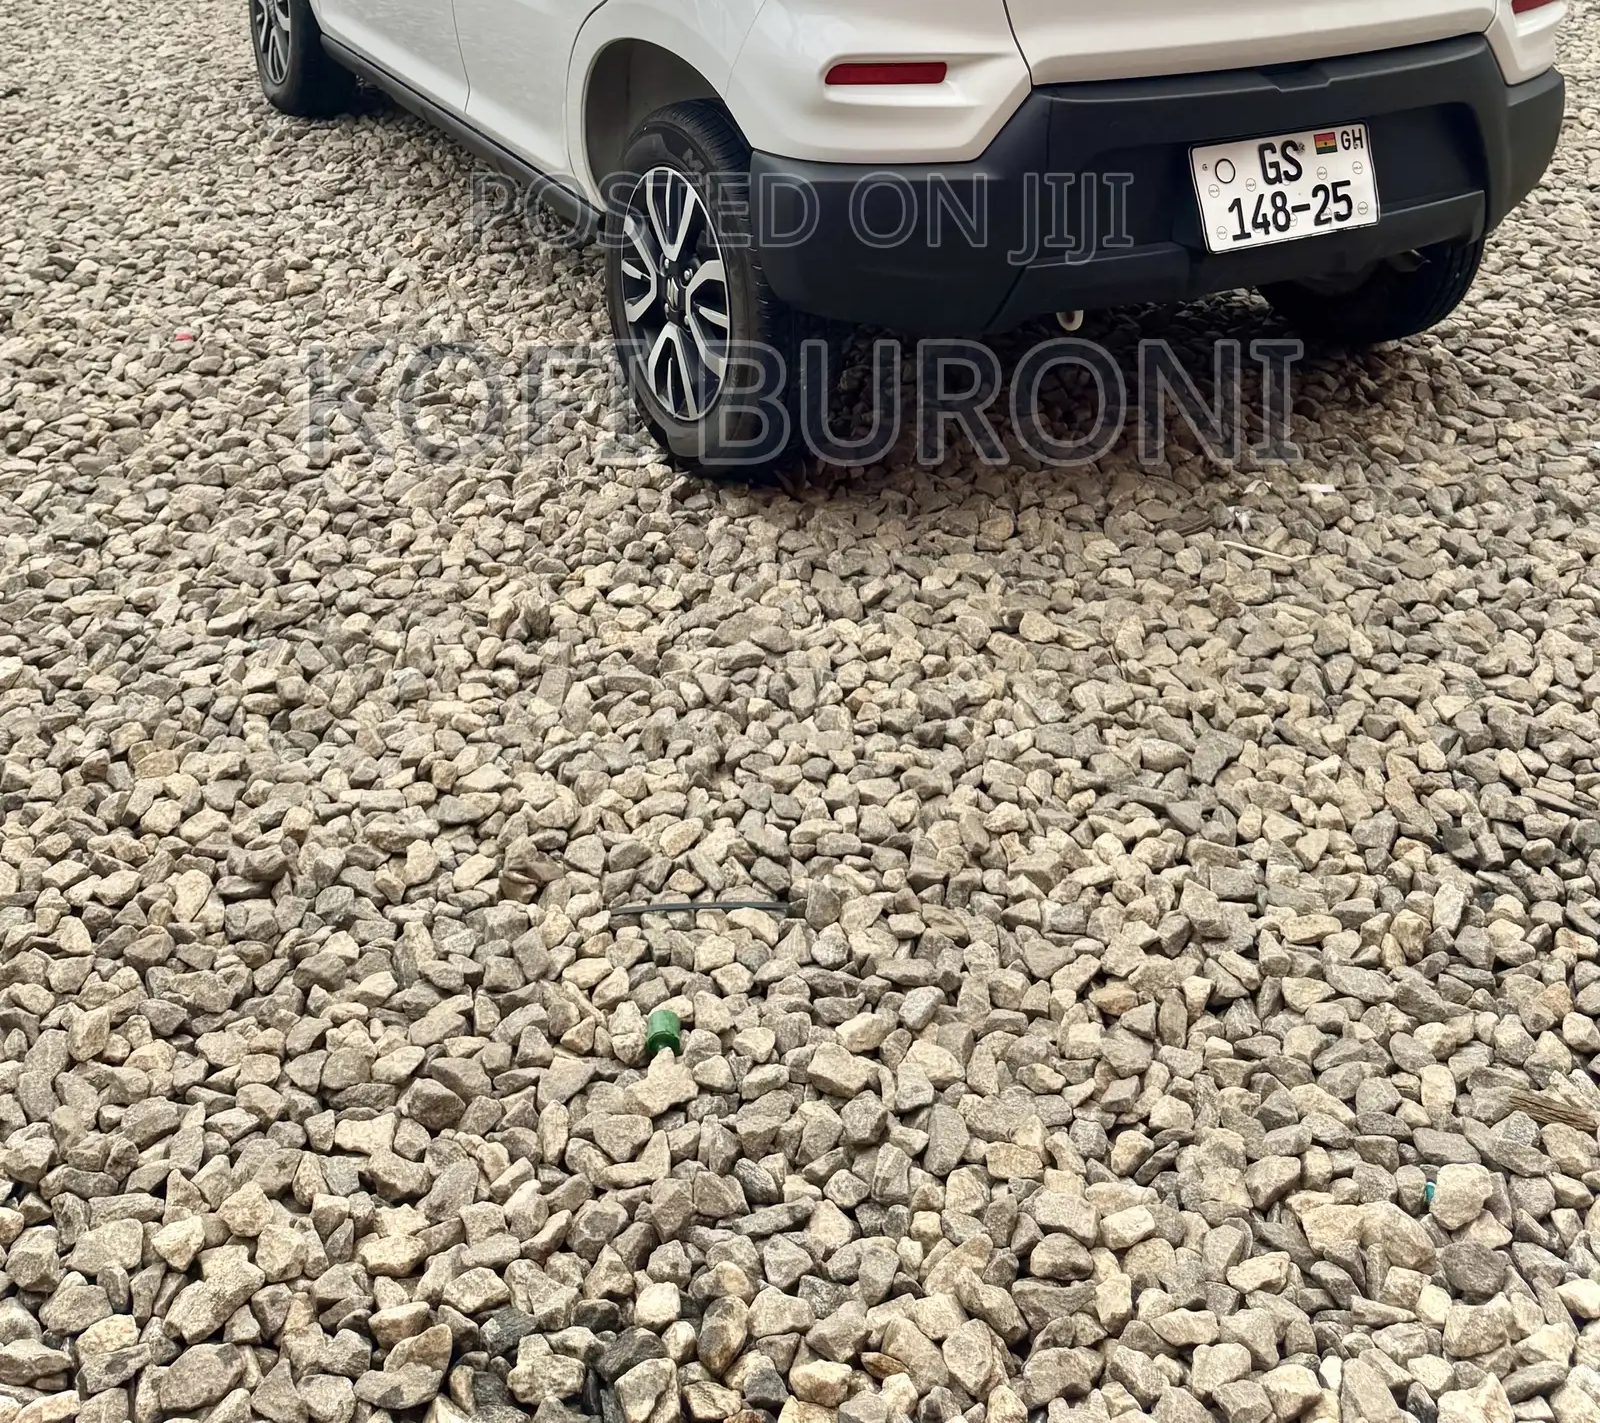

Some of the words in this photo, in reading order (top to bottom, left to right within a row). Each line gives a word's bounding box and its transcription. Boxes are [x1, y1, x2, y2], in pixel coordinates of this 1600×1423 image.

[1258, 139, 1303, 186] GS
[1340, 128, 1364, 151] GH
[1227, 179, 1353, 242] 148-25
